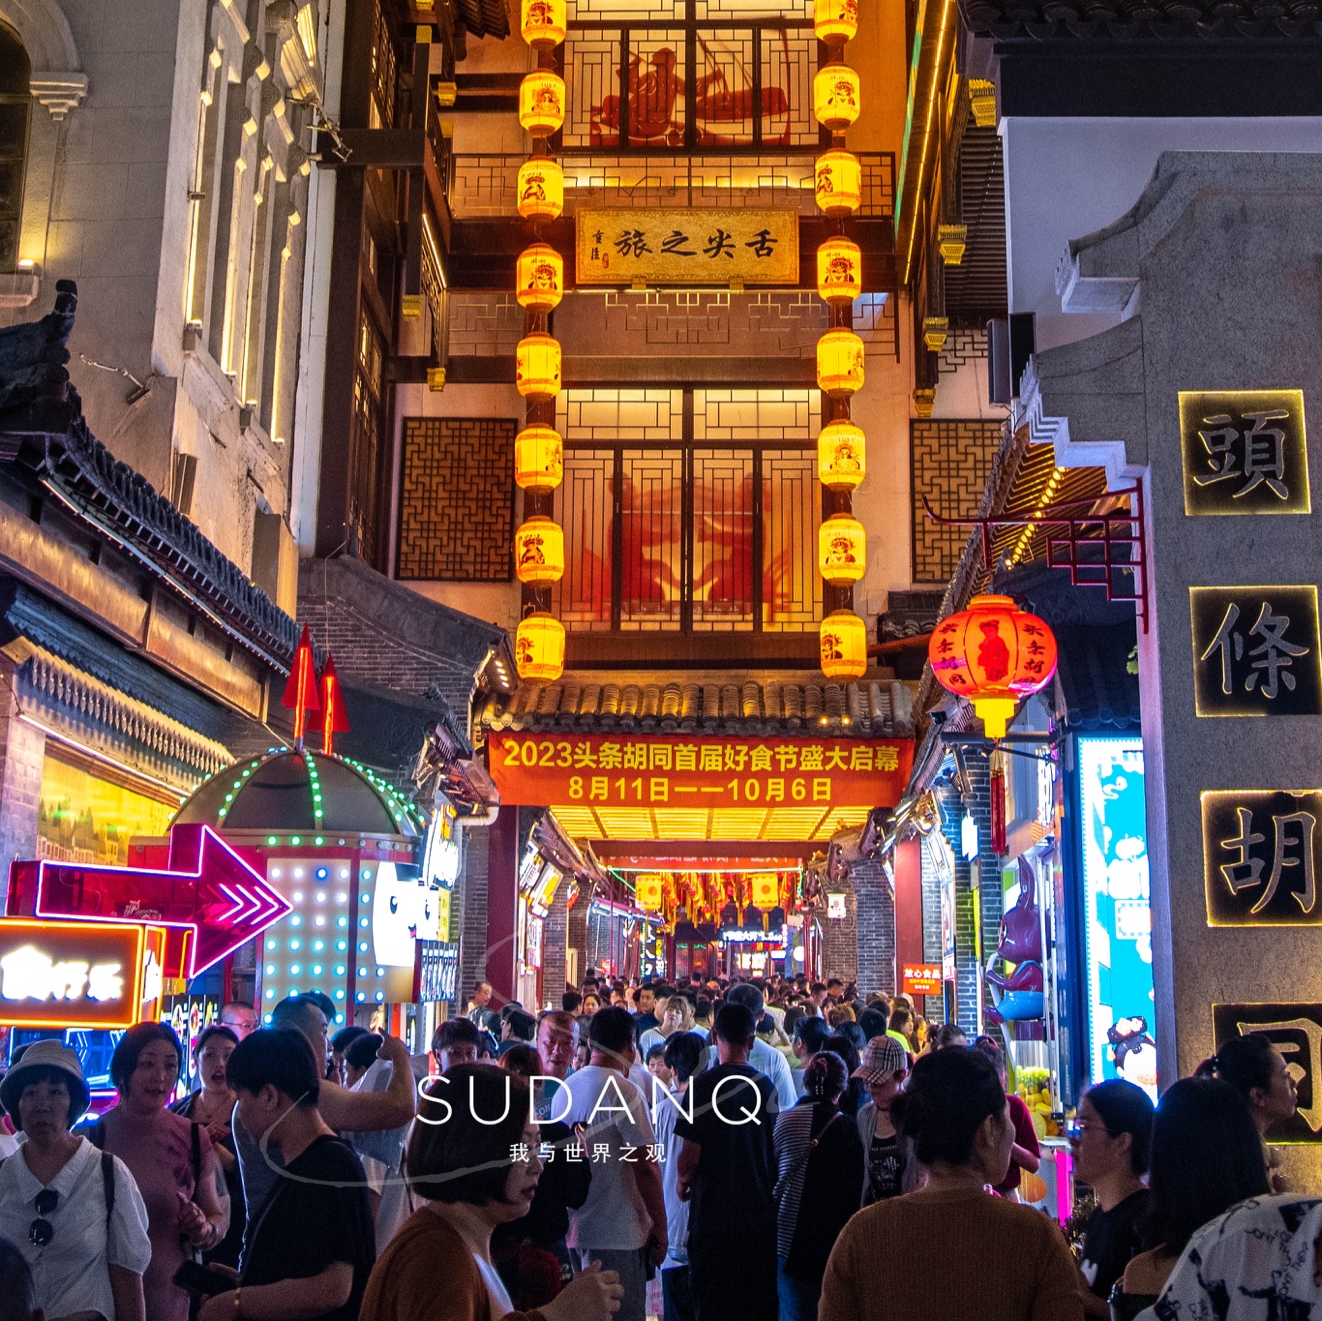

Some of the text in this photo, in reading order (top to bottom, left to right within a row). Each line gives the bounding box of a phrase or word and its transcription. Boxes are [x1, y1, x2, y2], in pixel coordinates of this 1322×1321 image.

[613, 229, 779, 259] 舌尖之旅
[503, 740, 900, 772] 2023头条胡同首届好食节盛大启幕
